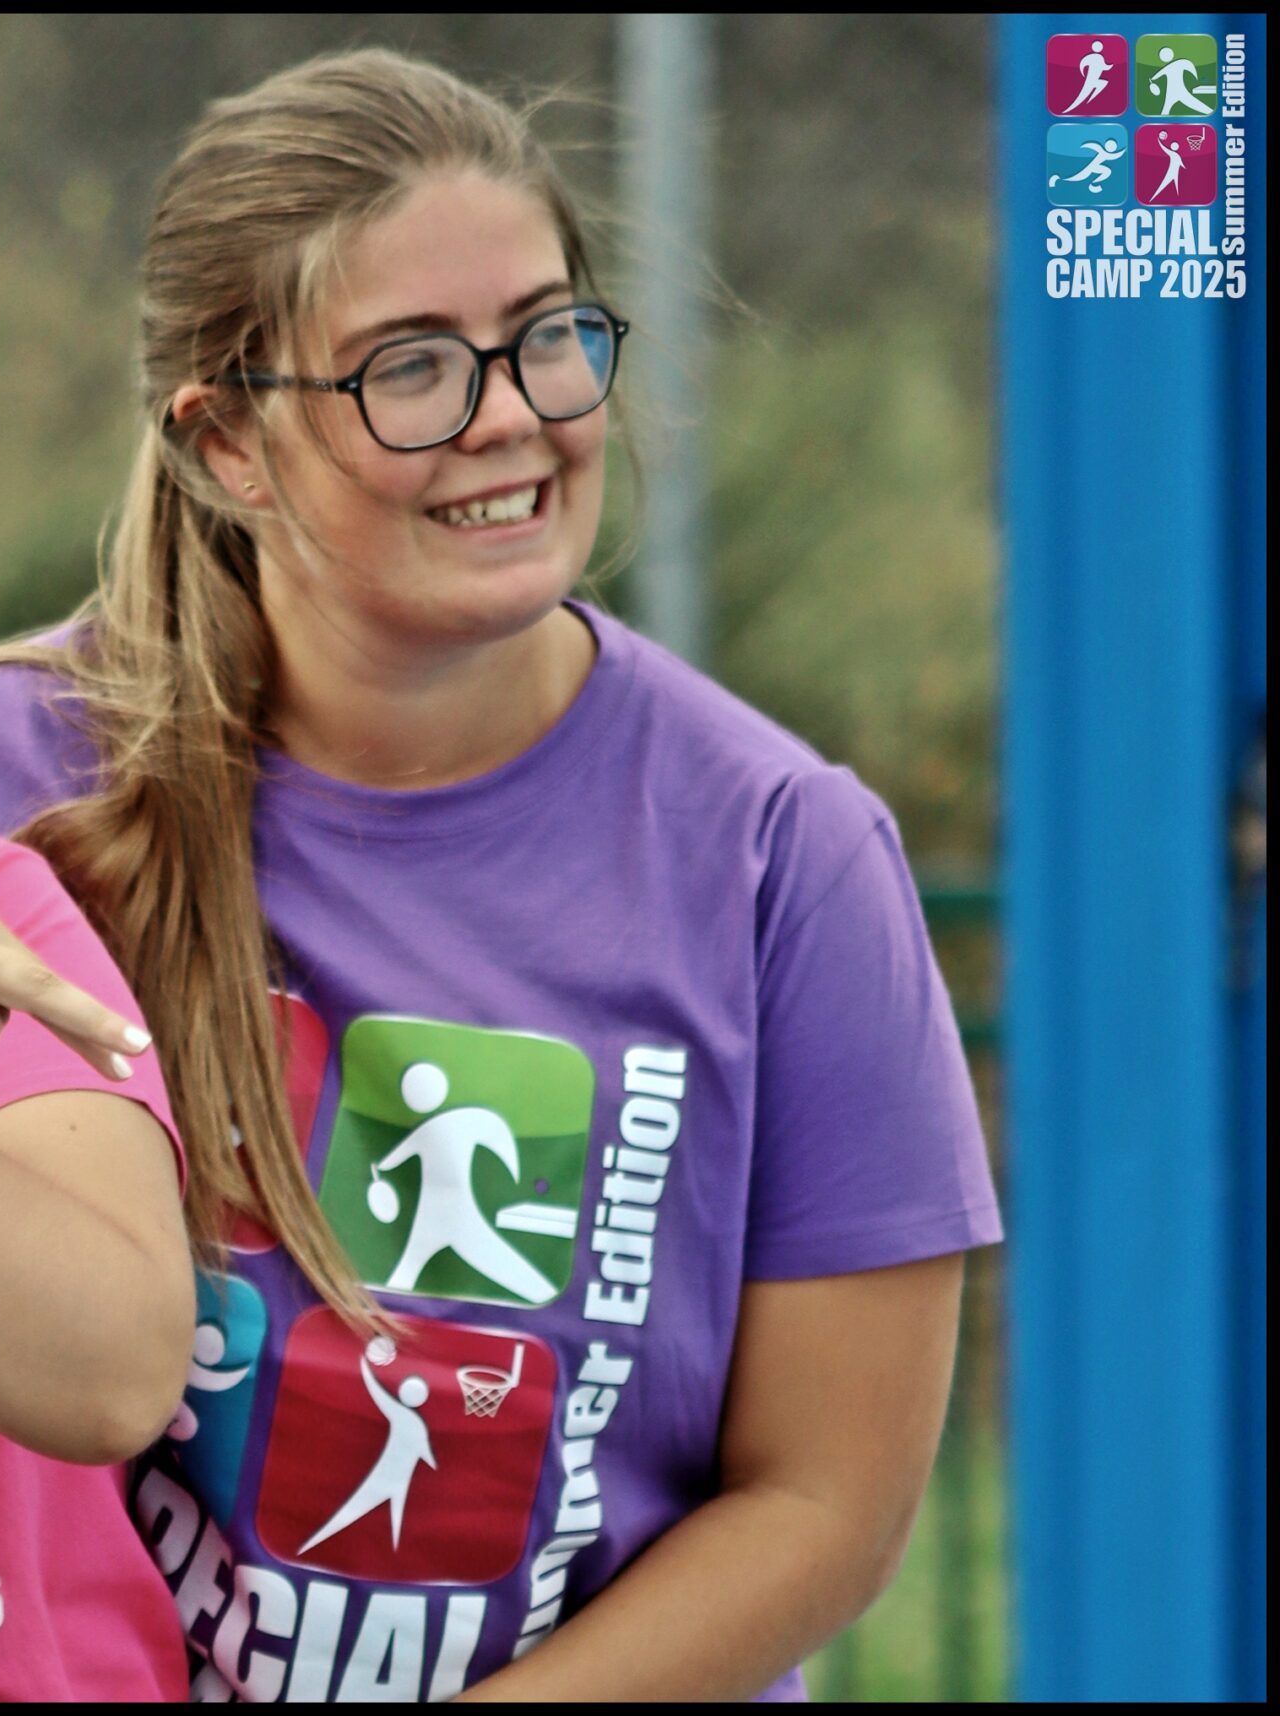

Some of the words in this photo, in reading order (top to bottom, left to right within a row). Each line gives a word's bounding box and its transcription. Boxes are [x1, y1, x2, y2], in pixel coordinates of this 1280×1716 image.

[511, 1341, 634, 1662] ummer
[583, 1045, 687, 1326] Edition
[136, 1466, 487, 1703] PECIAL
